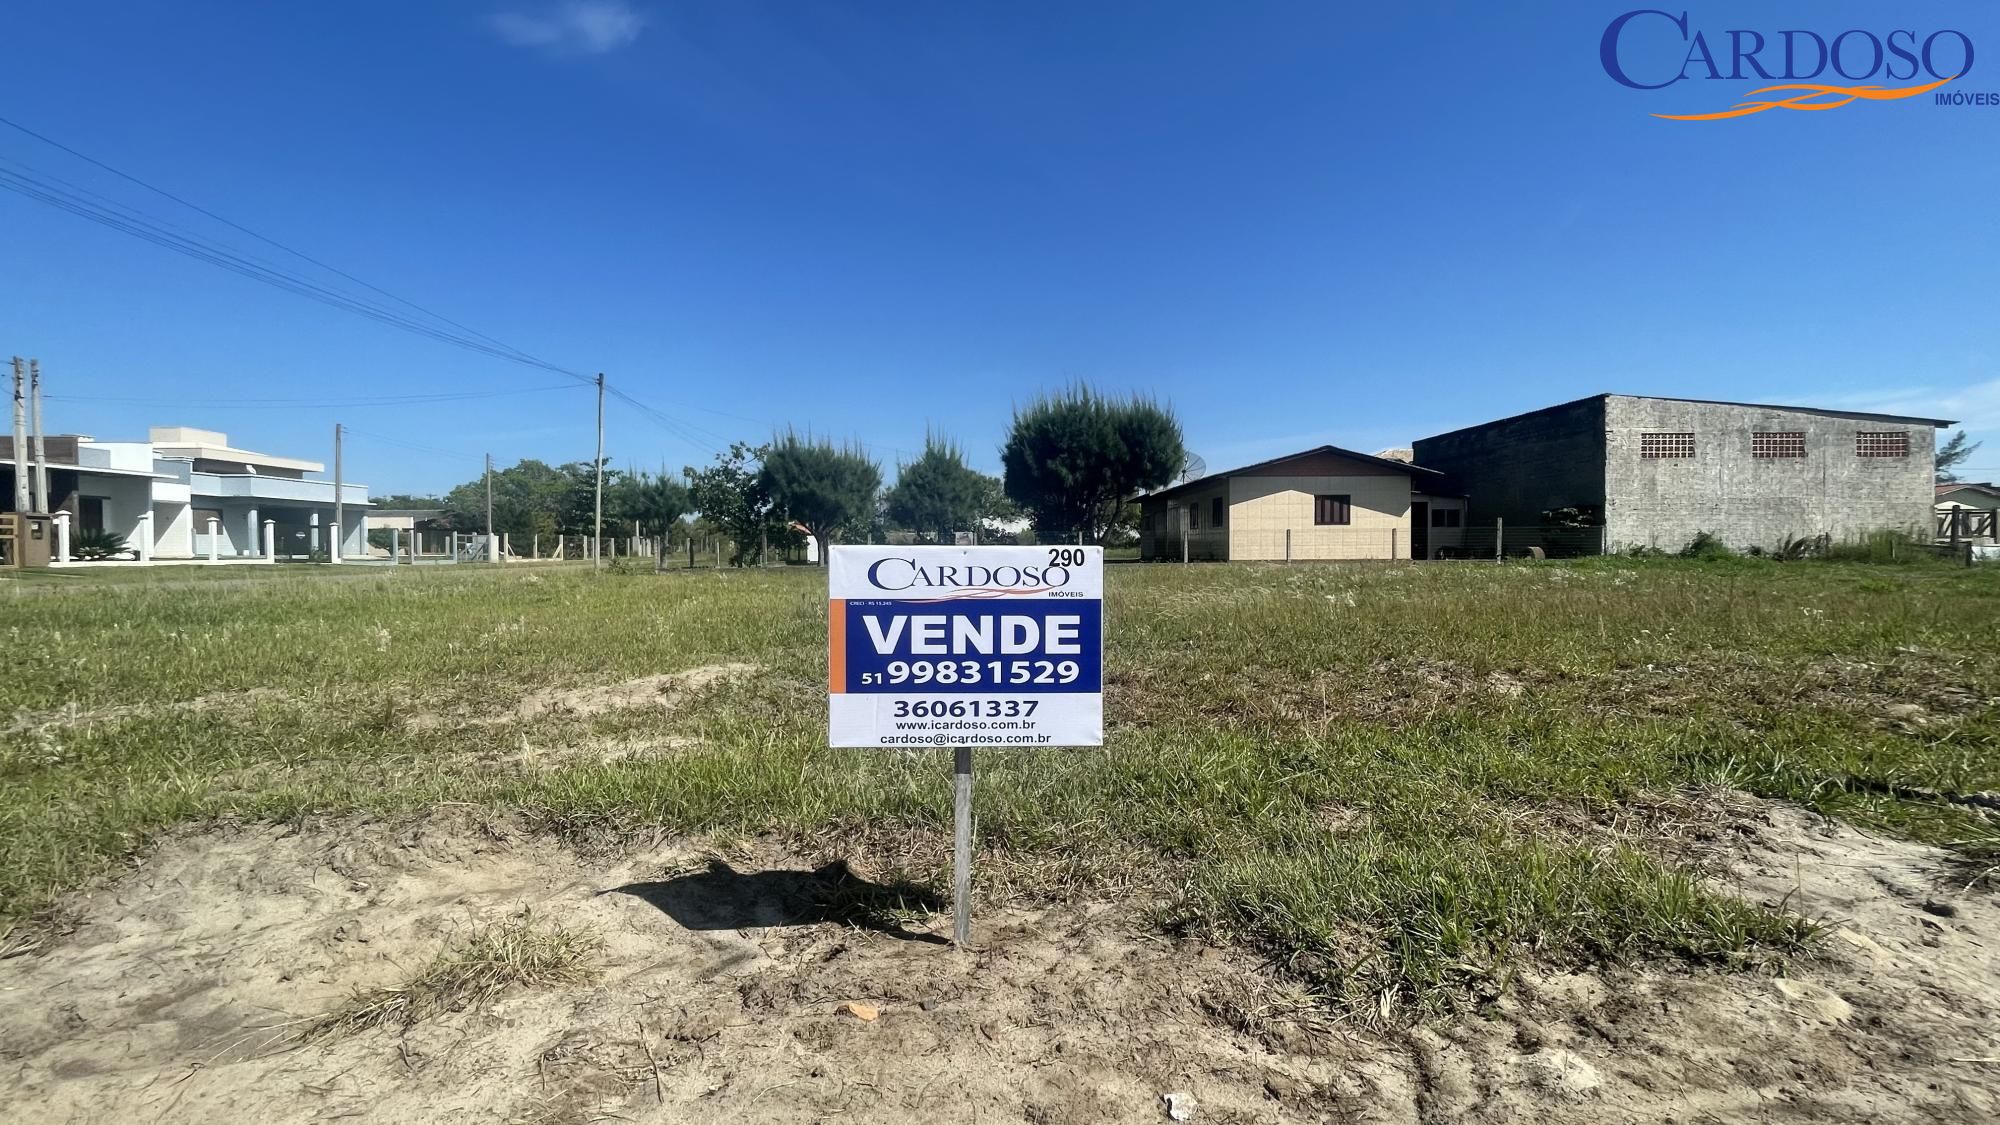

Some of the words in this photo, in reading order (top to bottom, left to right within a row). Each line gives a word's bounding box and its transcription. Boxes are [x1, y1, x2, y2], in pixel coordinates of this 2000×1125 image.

[1048, 548, 1085, 567] 290
[867, 557, 1070, 591] CARDOSO
[1048, 590, 1084, 598] IMÓVEIS
[862, 614, 1081, 655] VENDE
[861, 672, 882, 685] 51
[886, 660, 1080, 685] 99831529
[893, 699, 1039, 718] 36061337
[896, 719, 1036, 730] www.icardoso.com.br
[880, 733, 1052, 746] cardoso@icardoso.com.br
